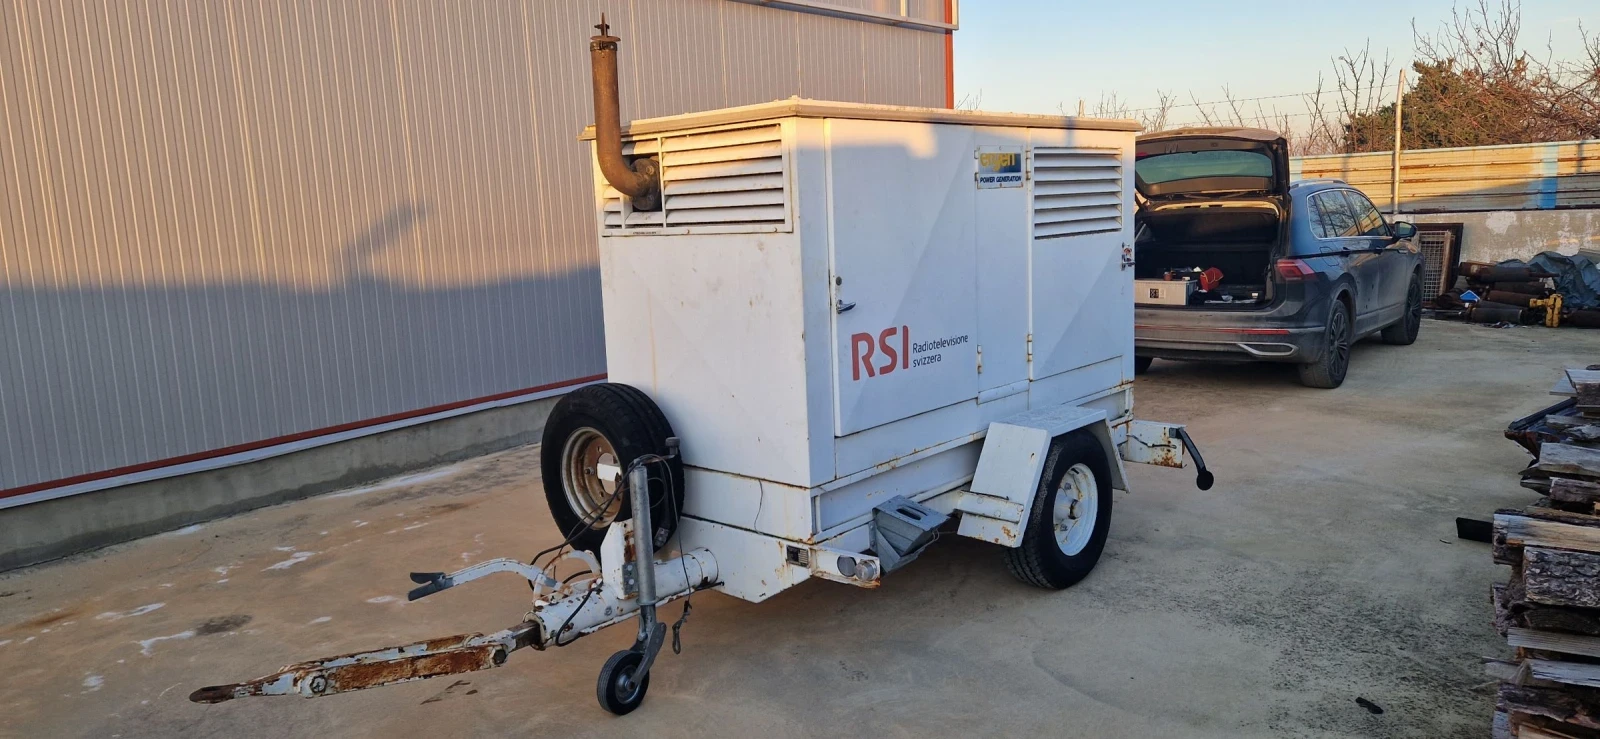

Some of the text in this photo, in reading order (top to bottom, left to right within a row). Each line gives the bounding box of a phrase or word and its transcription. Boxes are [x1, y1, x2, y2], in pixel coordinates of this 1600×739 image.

[996, 175, 1022, 183] GENERATION
[912, 334, 969, 354] Radiotelevisione
[851, 325, 909, 381] RSI
[912, 353, 942, 368] svizzera
